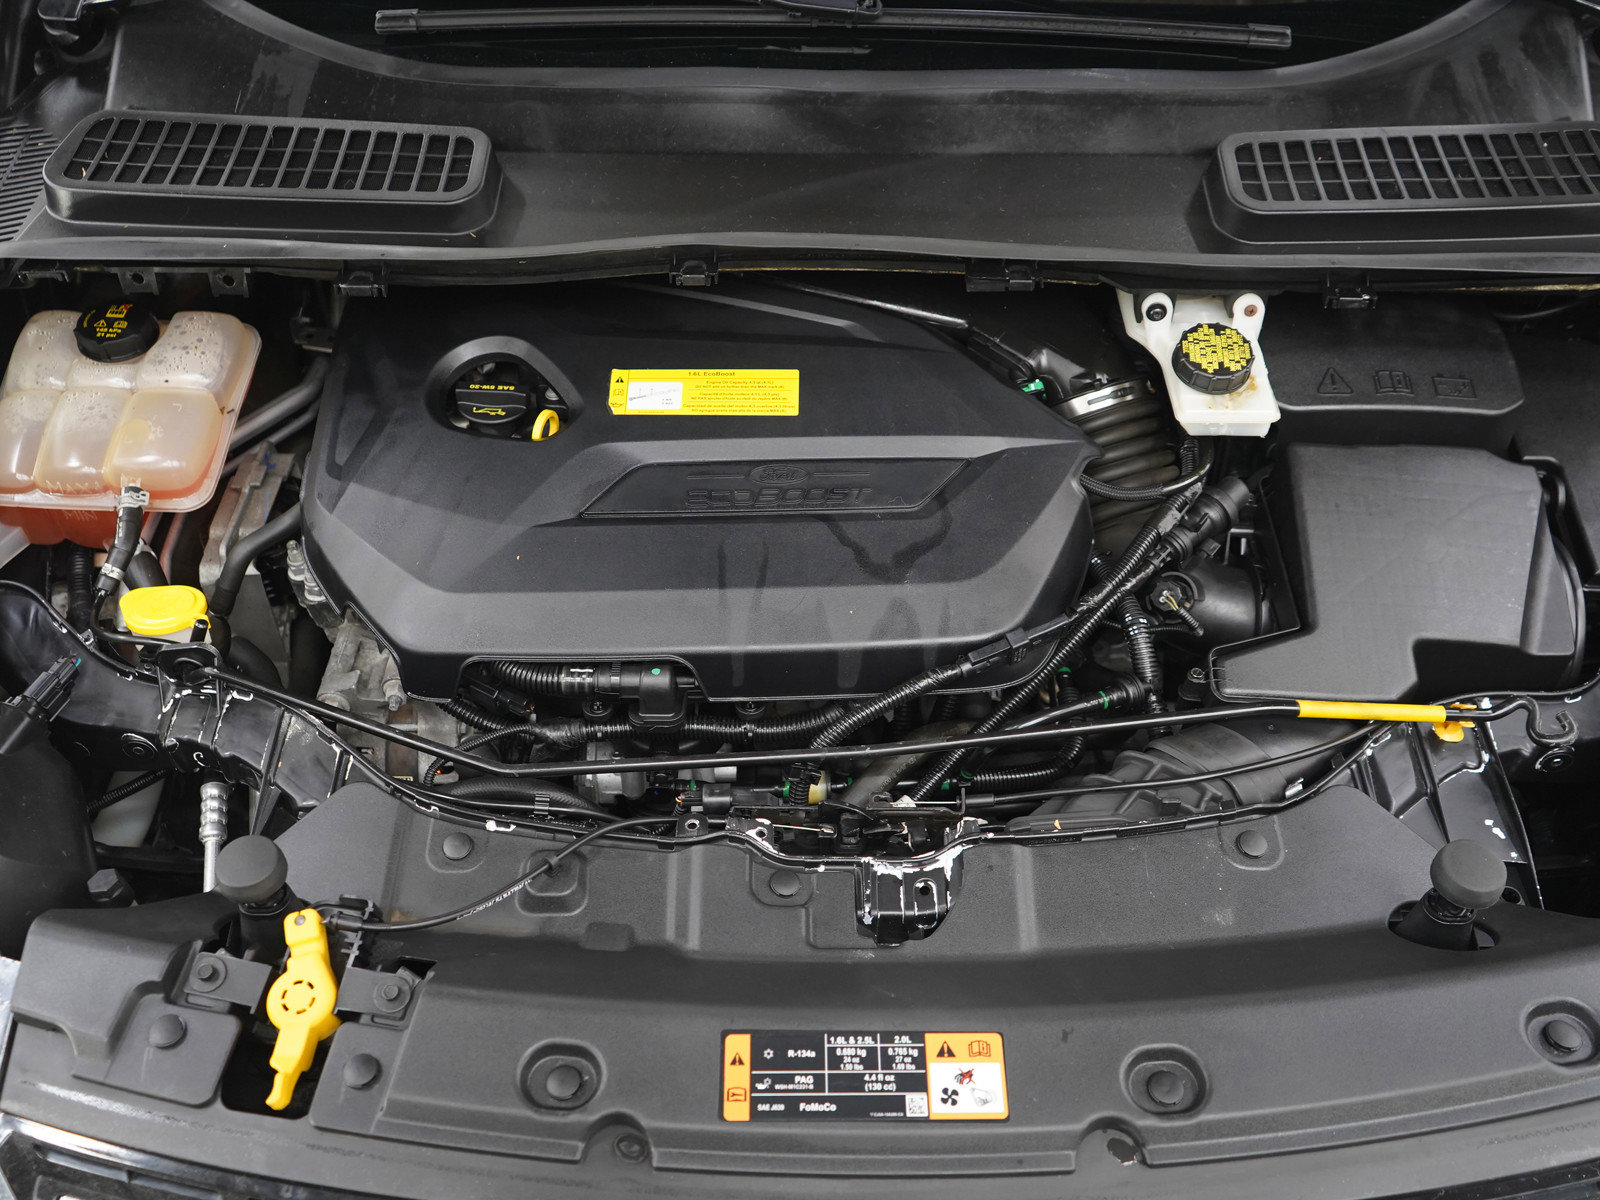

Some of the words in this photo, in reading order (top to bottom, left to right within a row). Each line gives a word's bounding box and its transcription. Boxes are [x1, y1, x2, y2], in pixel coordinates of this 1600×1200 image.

[760, 468, 796, 482] Ford
[787, 1049, 816, 1058] R-134a
[857, 1048, 867, 1058] kg
[908, 1048, 919, 1057] kg
[794, 1075, 814, 1084] PAG
[864, 1083, 882, 1092] (130
[799, 1102, 837, 1111] FoMoCo
